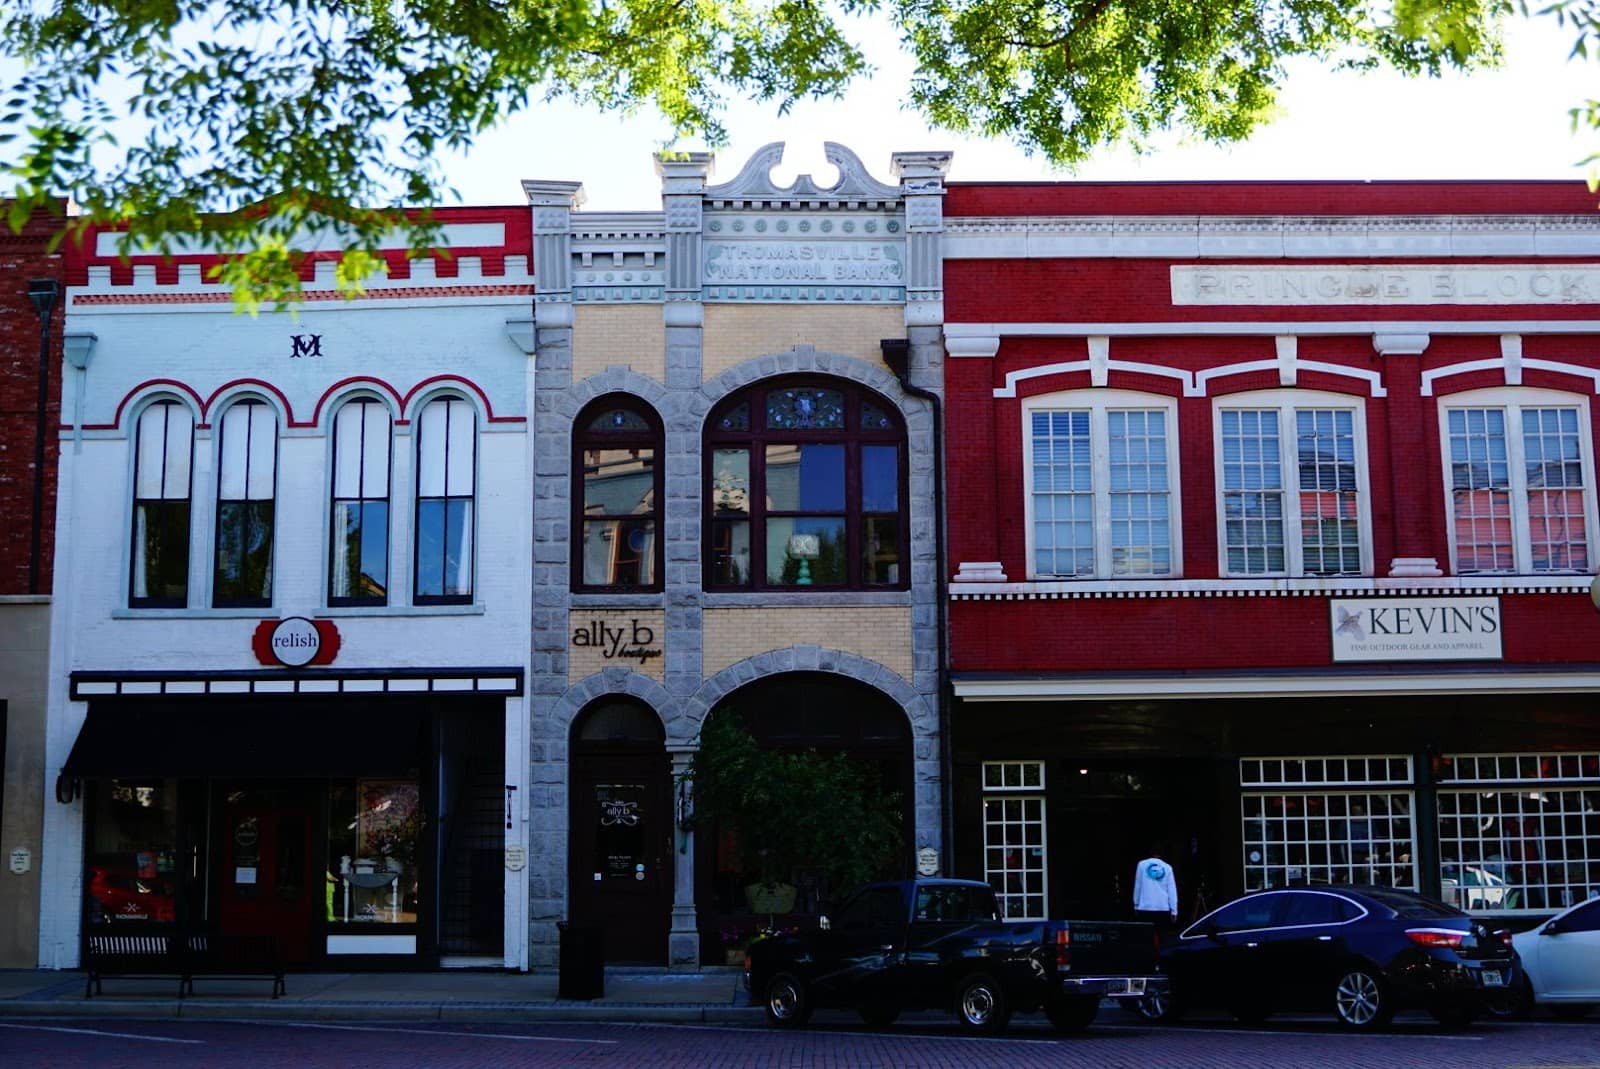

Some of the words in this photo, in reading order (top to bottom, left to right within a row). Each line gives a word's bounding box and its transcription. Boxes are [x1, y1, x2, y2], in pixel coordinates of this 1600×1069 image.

[720, 246, 880, 261] THOMASVILLE
[718, 264, 827, 280] NATIONAL
[833, 264, 891, 280] BANK
[1431, 272, 1588, 301] BLOCK
[1368, 604, 1498, 635] KEVIN'S
[273, 632, 317, 648] relish
[572, 620, 625, 659] ally
[631, 619, 654, 646] b
[1350, 644, 1368, 652] FINE
[1369, 643, 1408, 652] OUTDOOR
[1410, 643, 1431, 651] GEAR
[1433, 642, 1450, 650] AND
[1452, 641, 1485, 650] APPAREL
[617, 642, 662, 665] boutique
